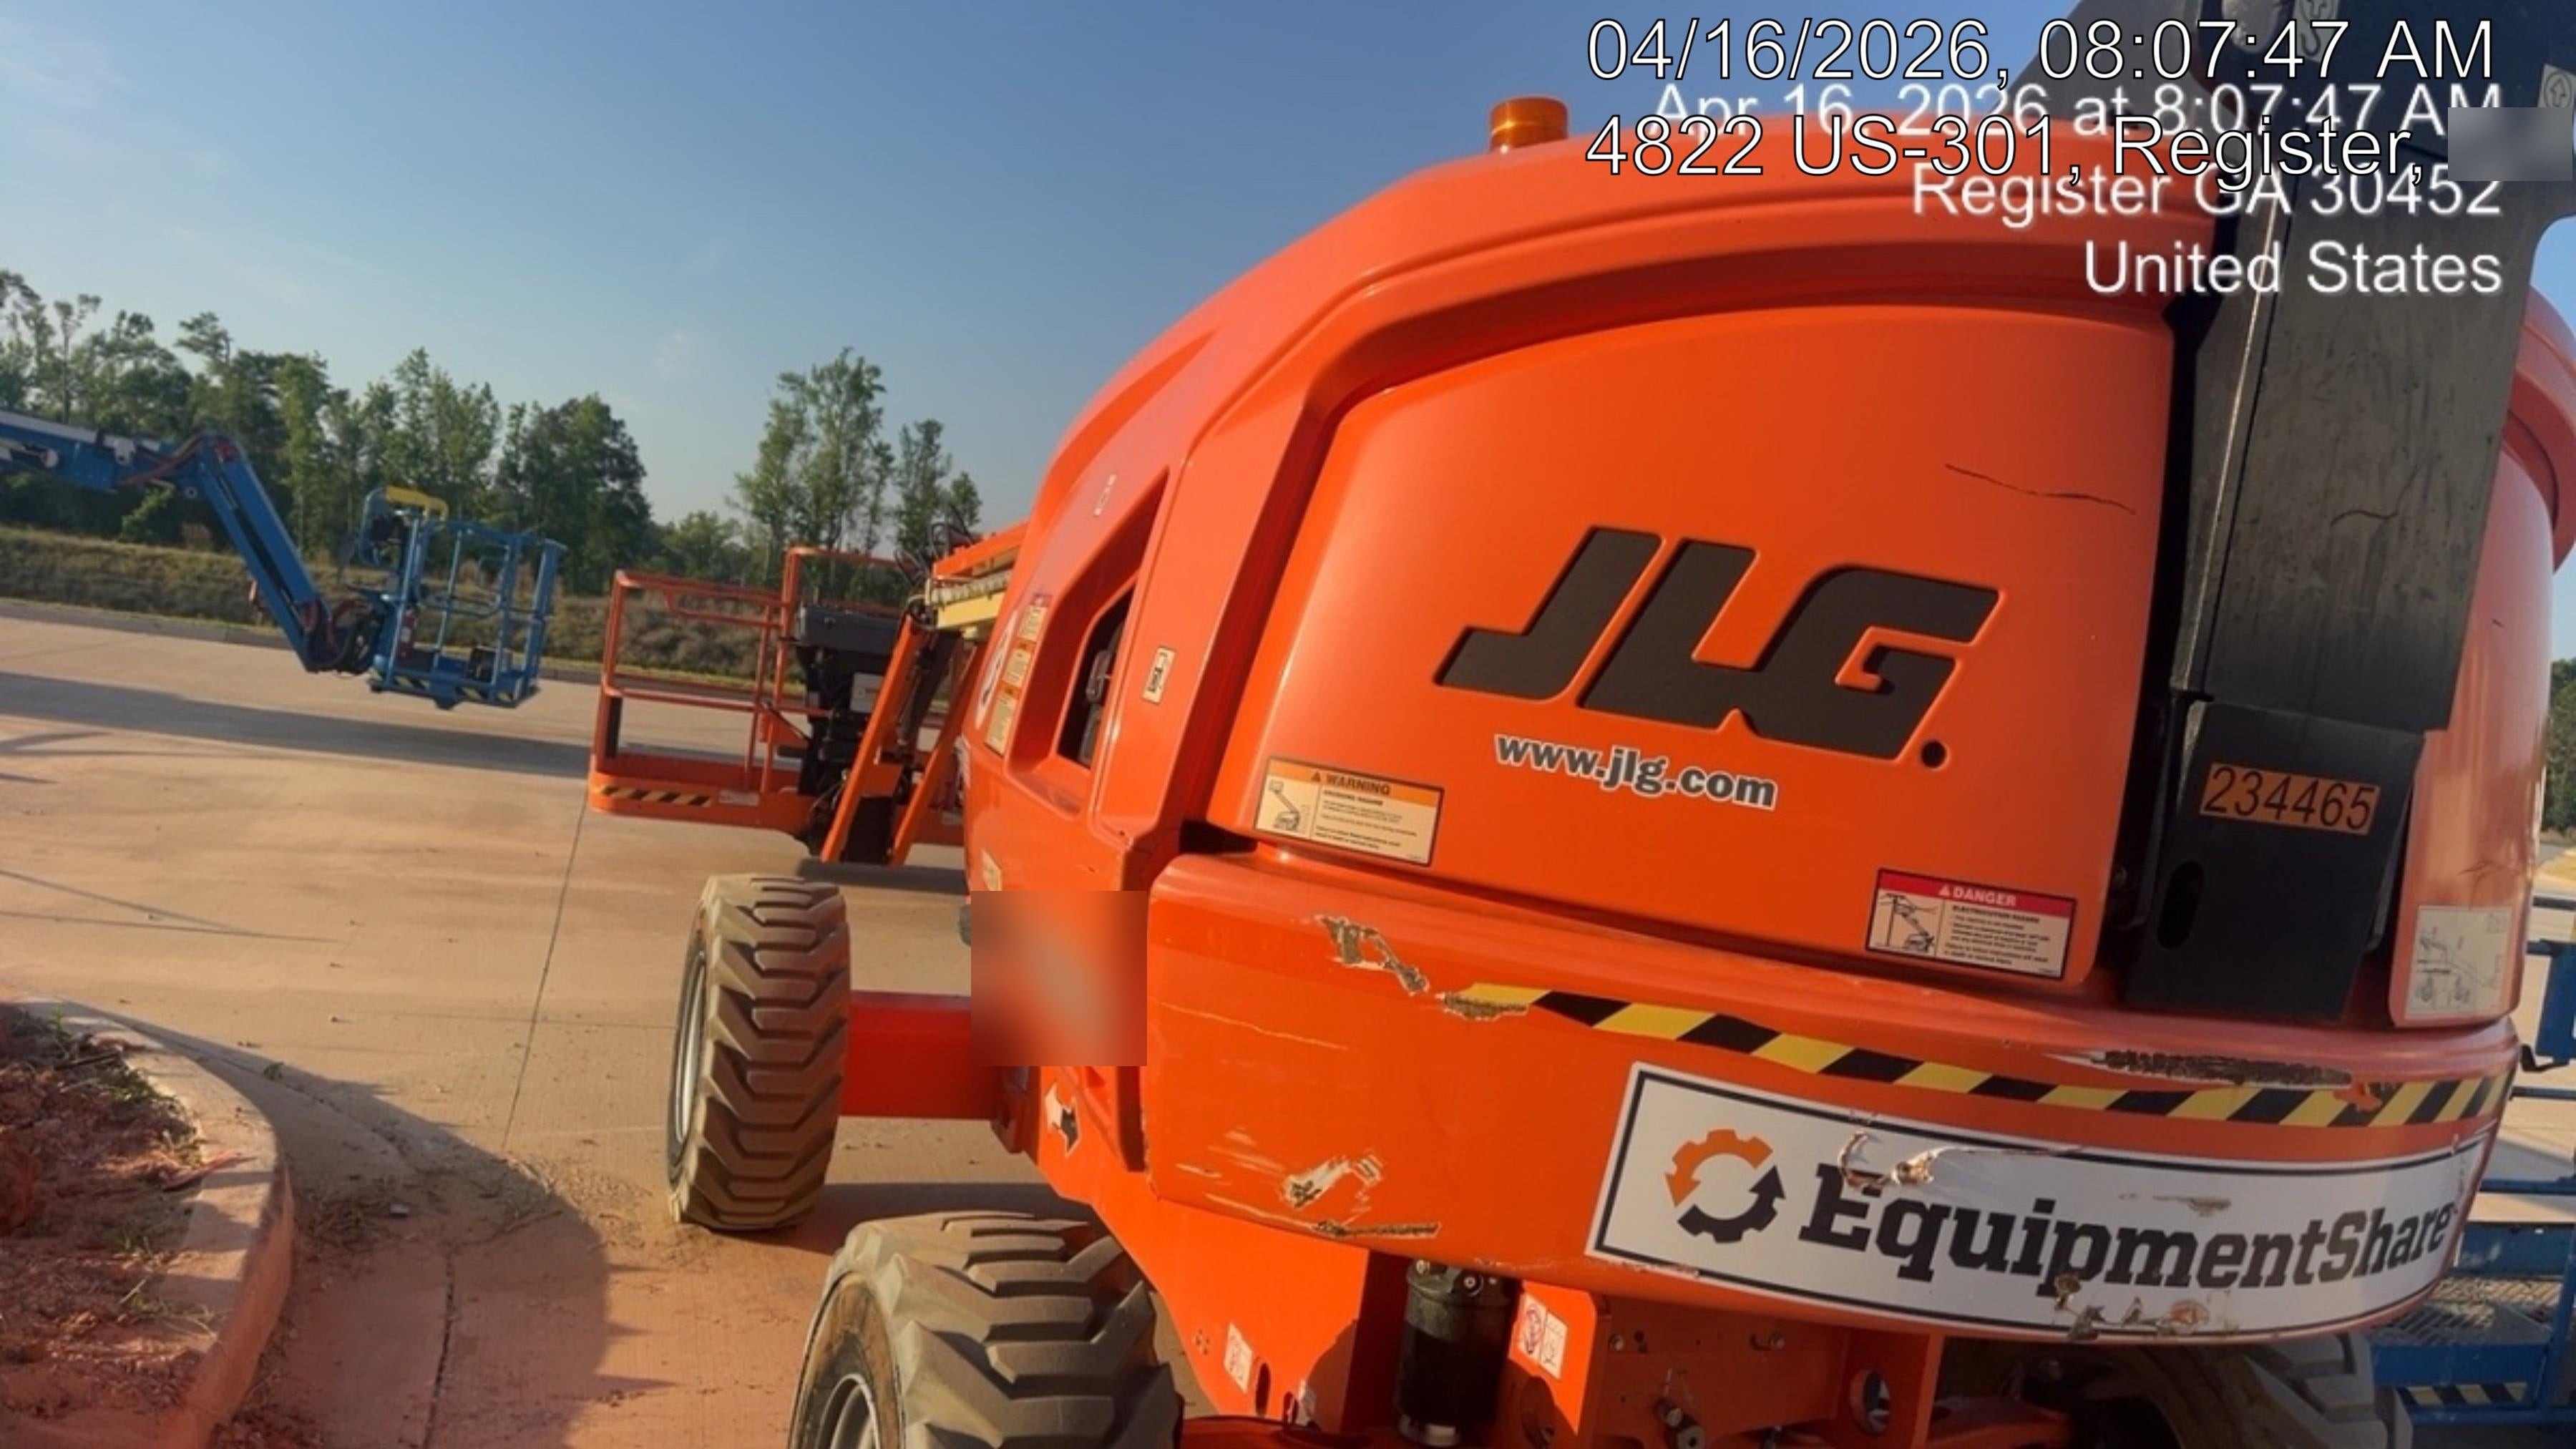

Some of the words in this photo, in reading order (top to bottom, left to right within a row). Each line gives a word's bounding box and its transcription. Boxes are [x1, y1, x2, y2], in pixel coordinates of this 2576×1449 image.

[1326, 773, 1392, 796] WARNING
[1495, 733, 1777, 810] www.jlg.com
[2202, 766, 2376, 831] 234465
[1952, 887, 2017, 907] DANGER
[1798, 1163, 2457, 1297] EquipmentShare
